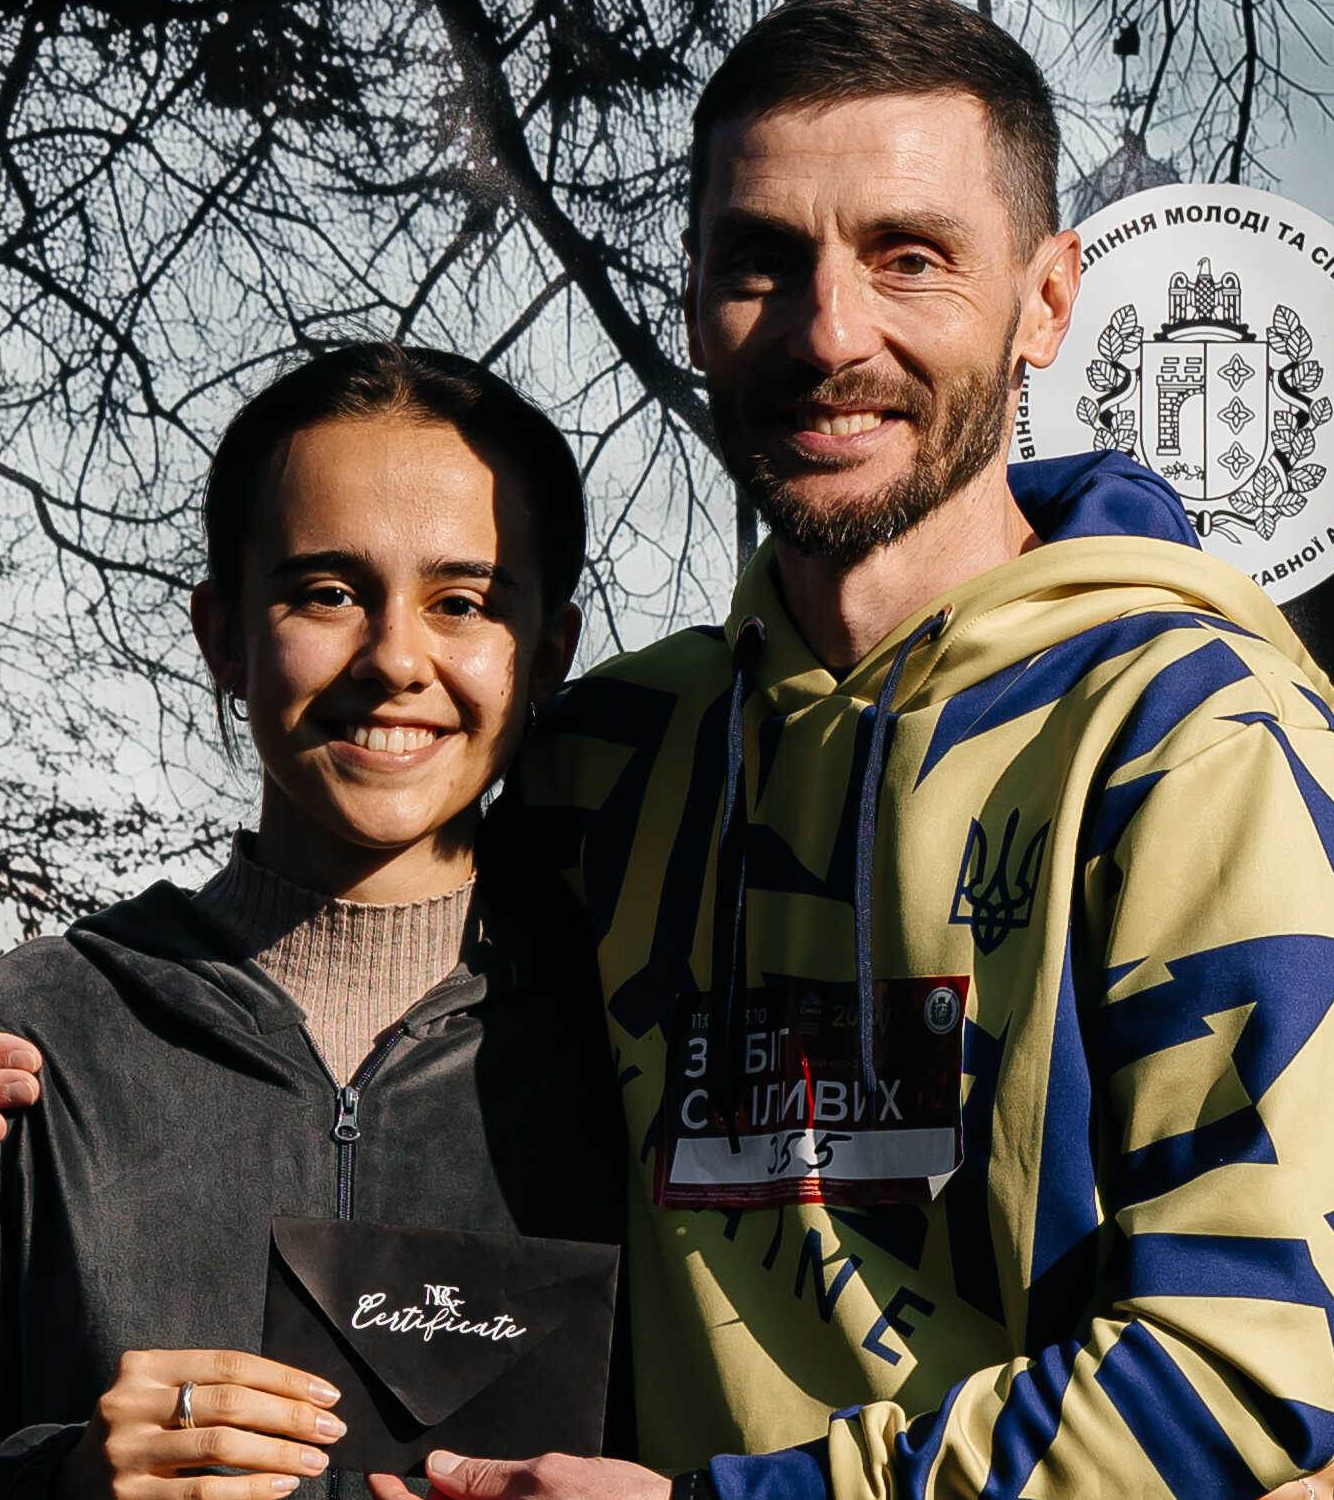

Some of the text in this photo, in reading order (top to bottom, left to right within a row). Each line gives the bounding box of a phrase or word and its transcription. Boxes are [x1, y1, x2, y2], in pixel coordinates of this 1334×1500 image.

[1164, 204, 1270, 234] МОЛОДІ
[1277, 221, 1308, 252] ТА
[683, 1028, 790, 1079] ЗБІГ
[680, 1078, 904, 1130] СІЛИВИХ
[350, 1291, 528, 1342] Certificate
